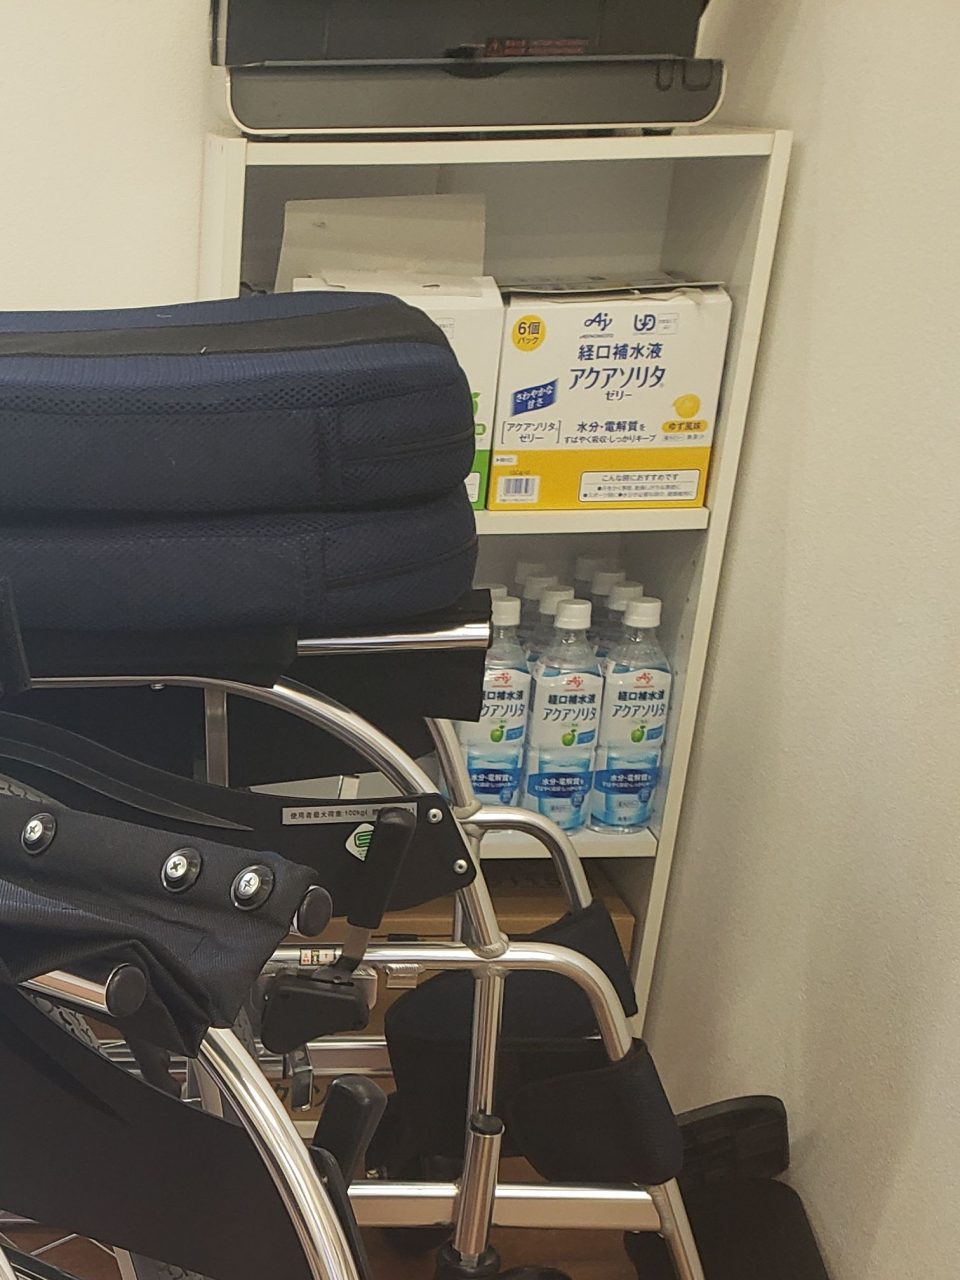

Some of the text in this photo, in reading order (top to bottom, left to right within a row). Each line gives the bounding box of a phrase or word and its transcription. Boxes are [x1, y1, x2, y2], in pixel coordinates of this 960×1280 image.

[518, 322, 540, 335] 6個
[517, 336, 539, 345] パック
[578, 343, 663, 361] 経口補水液
[569, 365, 666, 390] アクアソリタ
[516, 385, 553, 403] さわやかな
[606, 390, 632, 401] ゼリー
[577, 420, 646, 433] 水分・電解質を
[519, 434, 544, 443] ゼリー
[482, 690, 524, 700] 口補水液
[542, 707, 597, 722] アクアソリタ
[612, 703, 666, 718] アクアソリタ
